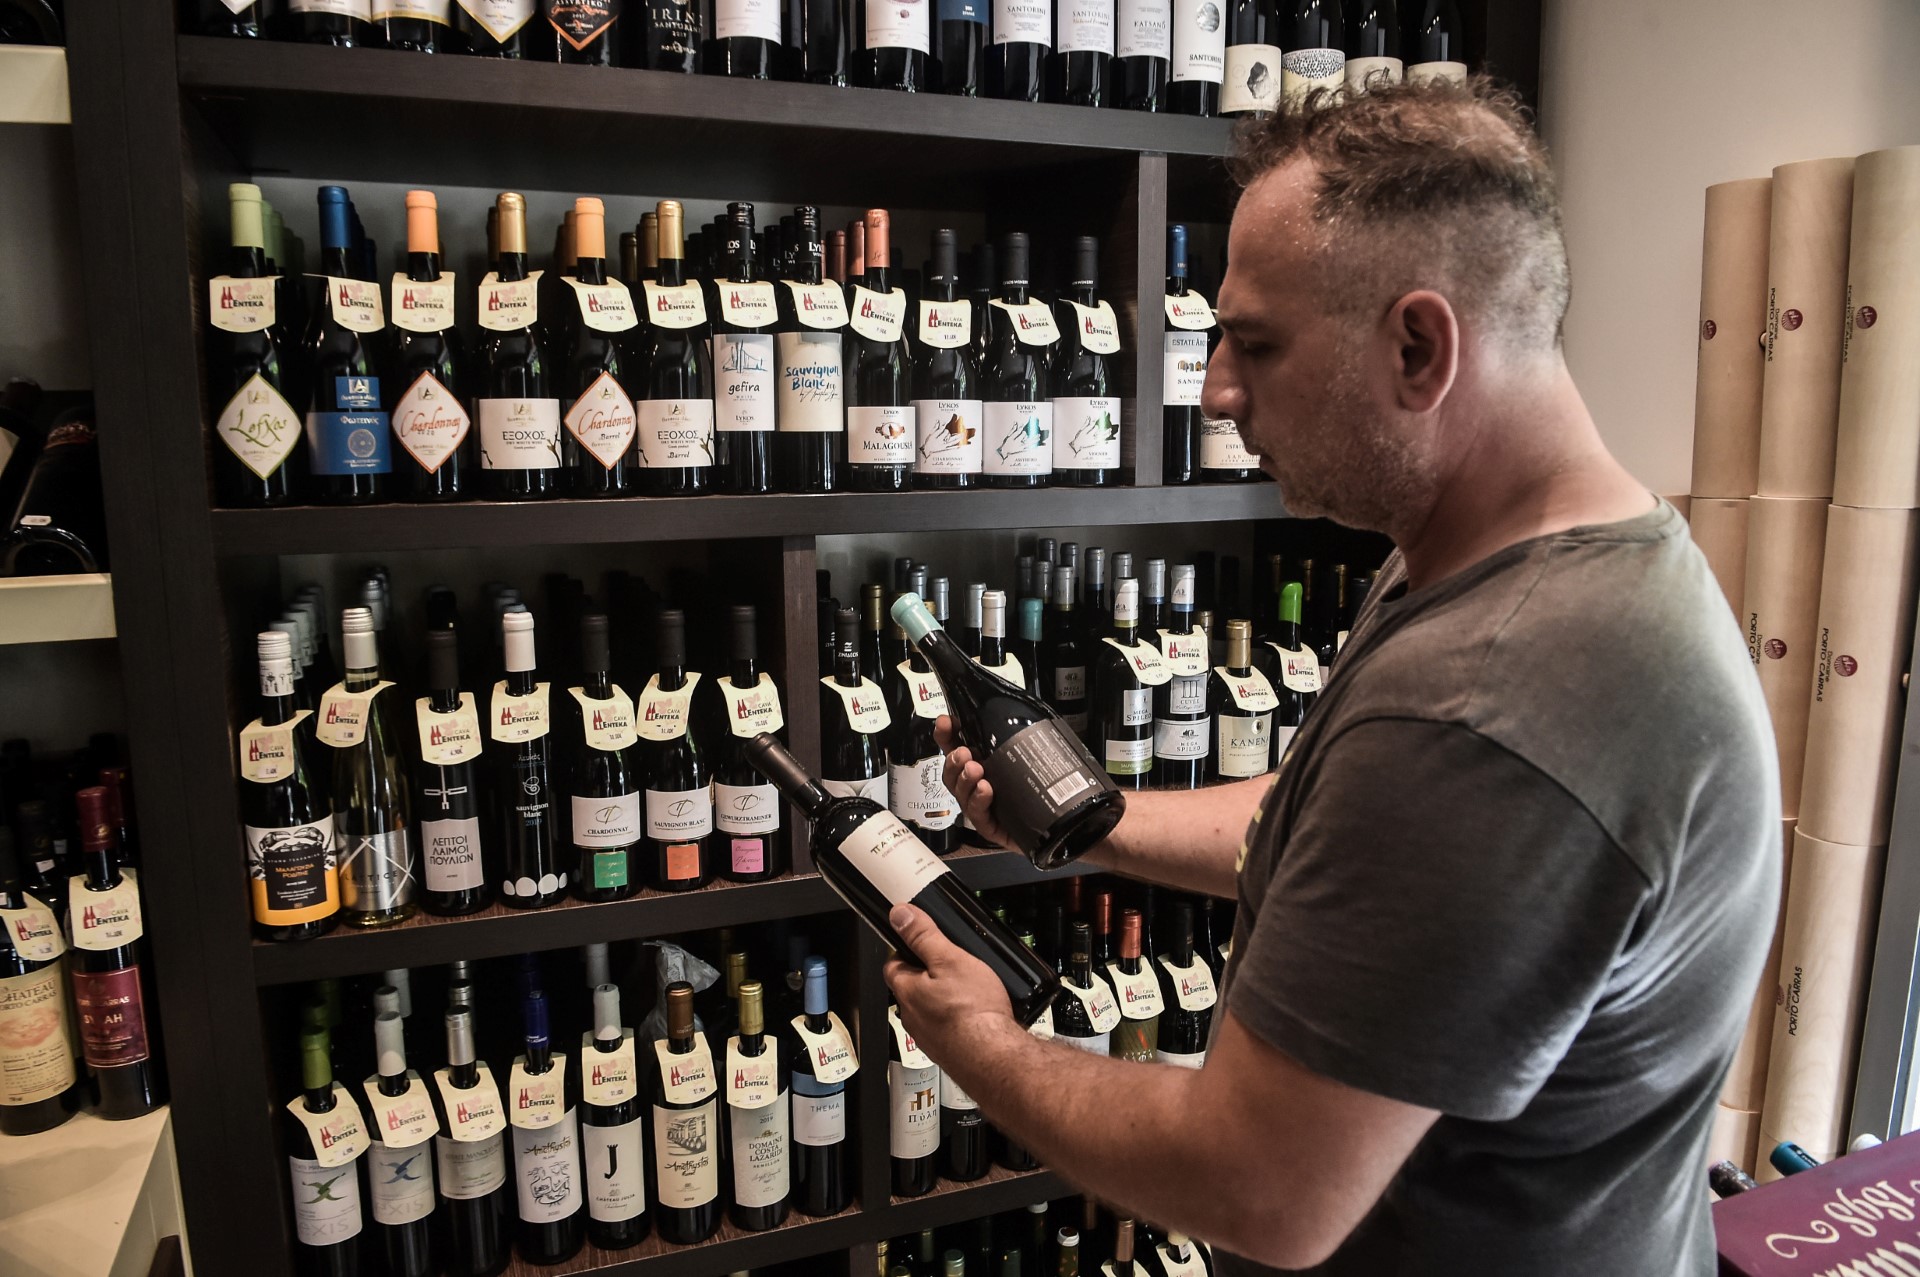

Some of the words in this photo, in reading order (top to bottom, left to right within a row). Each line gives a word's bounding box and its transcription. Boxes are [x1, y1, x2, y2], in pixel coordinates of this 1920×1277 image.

[1007, 6, 1046, 16] SANTORINI
[1072, 11, 1110, 21] SANTORINI
[232, 299, 264, 308] ENTEKA
[349, 299, 374, 309] ENTEKA
[414, 301, 444, 309] ENTEKA
[599, 304, 626, 312] ENTEKA
[870, 312, 895, 324] ENTEKA
[937, 320, 962, 328] ENTEKA
[728, 381, 760, 395] gefira
[400, 406, 462, 438] Chardonnay
[579, 405, 633, 436] Chardonnay
[502, 430, 546, 441] ΕΞΟΧΟΣ
[600, 432, 620, 440] Barrel
[657, 430, 699, 441] ΕΞΟΧΟΣ
[667, 451, 690, 459] Barrel
[1749, 612, 1758, 642] PORTO
[1819, 627, 1829, 660] PORTO
[1816, 663, 1826, 702] CARRAS
[928, 691, 944, 699] ENTE
[747, 707, 773, 716] ENTEKA
[335, 716, 358, 725] ENTEKA
[512, 715, 540, 723] ENTEKA
[1126, 713, 1152, 722] SPILEO
[441, 734, 471, 743] ENTEKA
[258, 751, 285, 759] ENTEKA
[516, 802, 549, 813] sauvignon
[523, 810, 542, 818] blanc
[654, 820, 688, 828] SAUVIGNON
[689, 818, 706, 826] BLANC
[587, 826, 629, 835] CHARDONNAY
[433, 834, 468, 846] ΛΕΠΤΟΙ
[433, 845, 469, 855] ΛΑΙΜΟΙ
[430, 853, 474, 865] ΠΟΥΛΙΩΝ
[96, 914, 130, 926] ENTEKA
[28, 929, 53, 939] ENTEKA
[1190, 985, 1208, 994] ENTEKA
[1134, 993, 1156, 1001] ENTEKA
[1788, 1006, 1798, 1036] PORTO
[1793, 966, 1803, 1003] CARRAS
[84, 1013, 122, 1024] SYAH
[827, 1052, 849, 1063] ENTEKA
[601, 1075, 628, 1083] ENTEKA
[680, 1073, 706, 1083] ENTEKA
[810, 1103, 840, 1112] THEMA
[468, 1109, 494, 1120] ENTEKA
[908, 1110, 937, 1124] Πύλη
[398, 1114, 426, 1126] ENTEKA
[331, 1129, 358, 1142] ENTEKA
[748, 1136, 783, 1150] DOMAINE
[749, 1147, 783, 1162] LAZARIDI
[754, 1144, 780, 1155] COSTA
[604, 1144, 619, 1180] J
